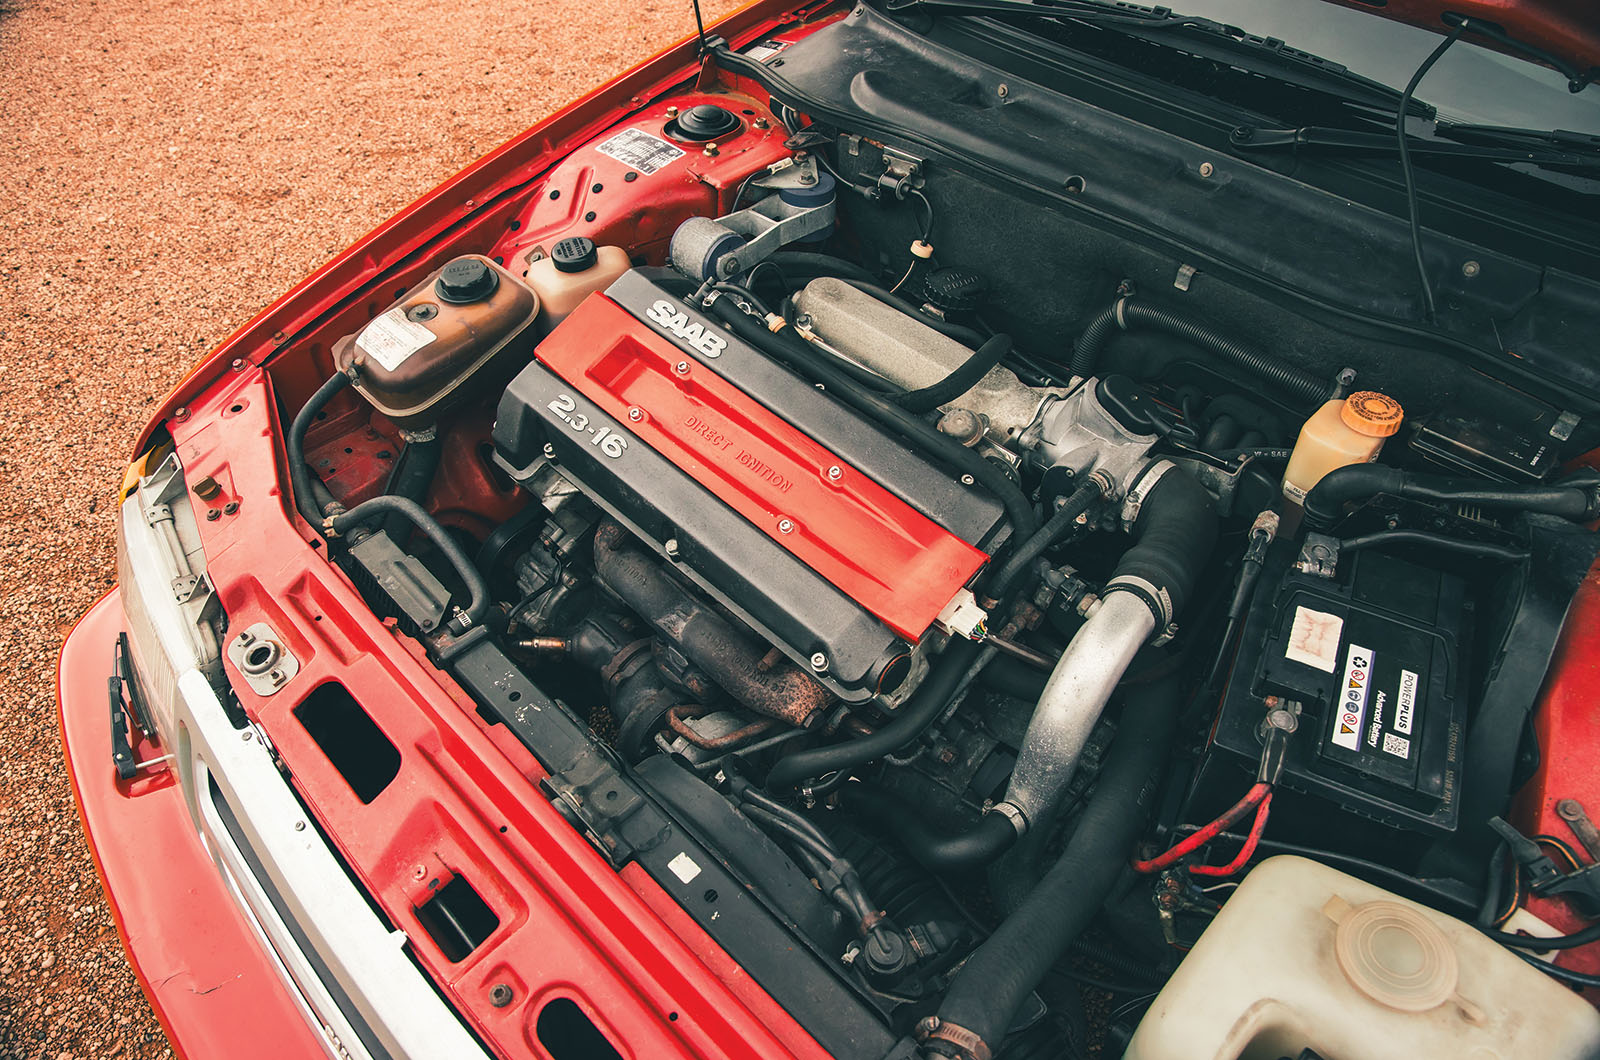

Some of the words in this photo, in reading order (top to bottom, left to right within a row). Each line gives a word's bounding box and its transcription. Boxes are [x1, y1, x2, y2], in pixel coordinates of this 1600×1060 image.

[646, 299, 728, 359] SAAB
[547, 394, 628, 459] 2.3-16
[684, 415, 733, 452] DIRECT
[735, 449, 793, 494] IGNITION
[1373, 689, 1387, 724] Advanced
[1398, 674, 1414, 729] POWERPLUS
[1367, 721, 1382, 748] Battery
